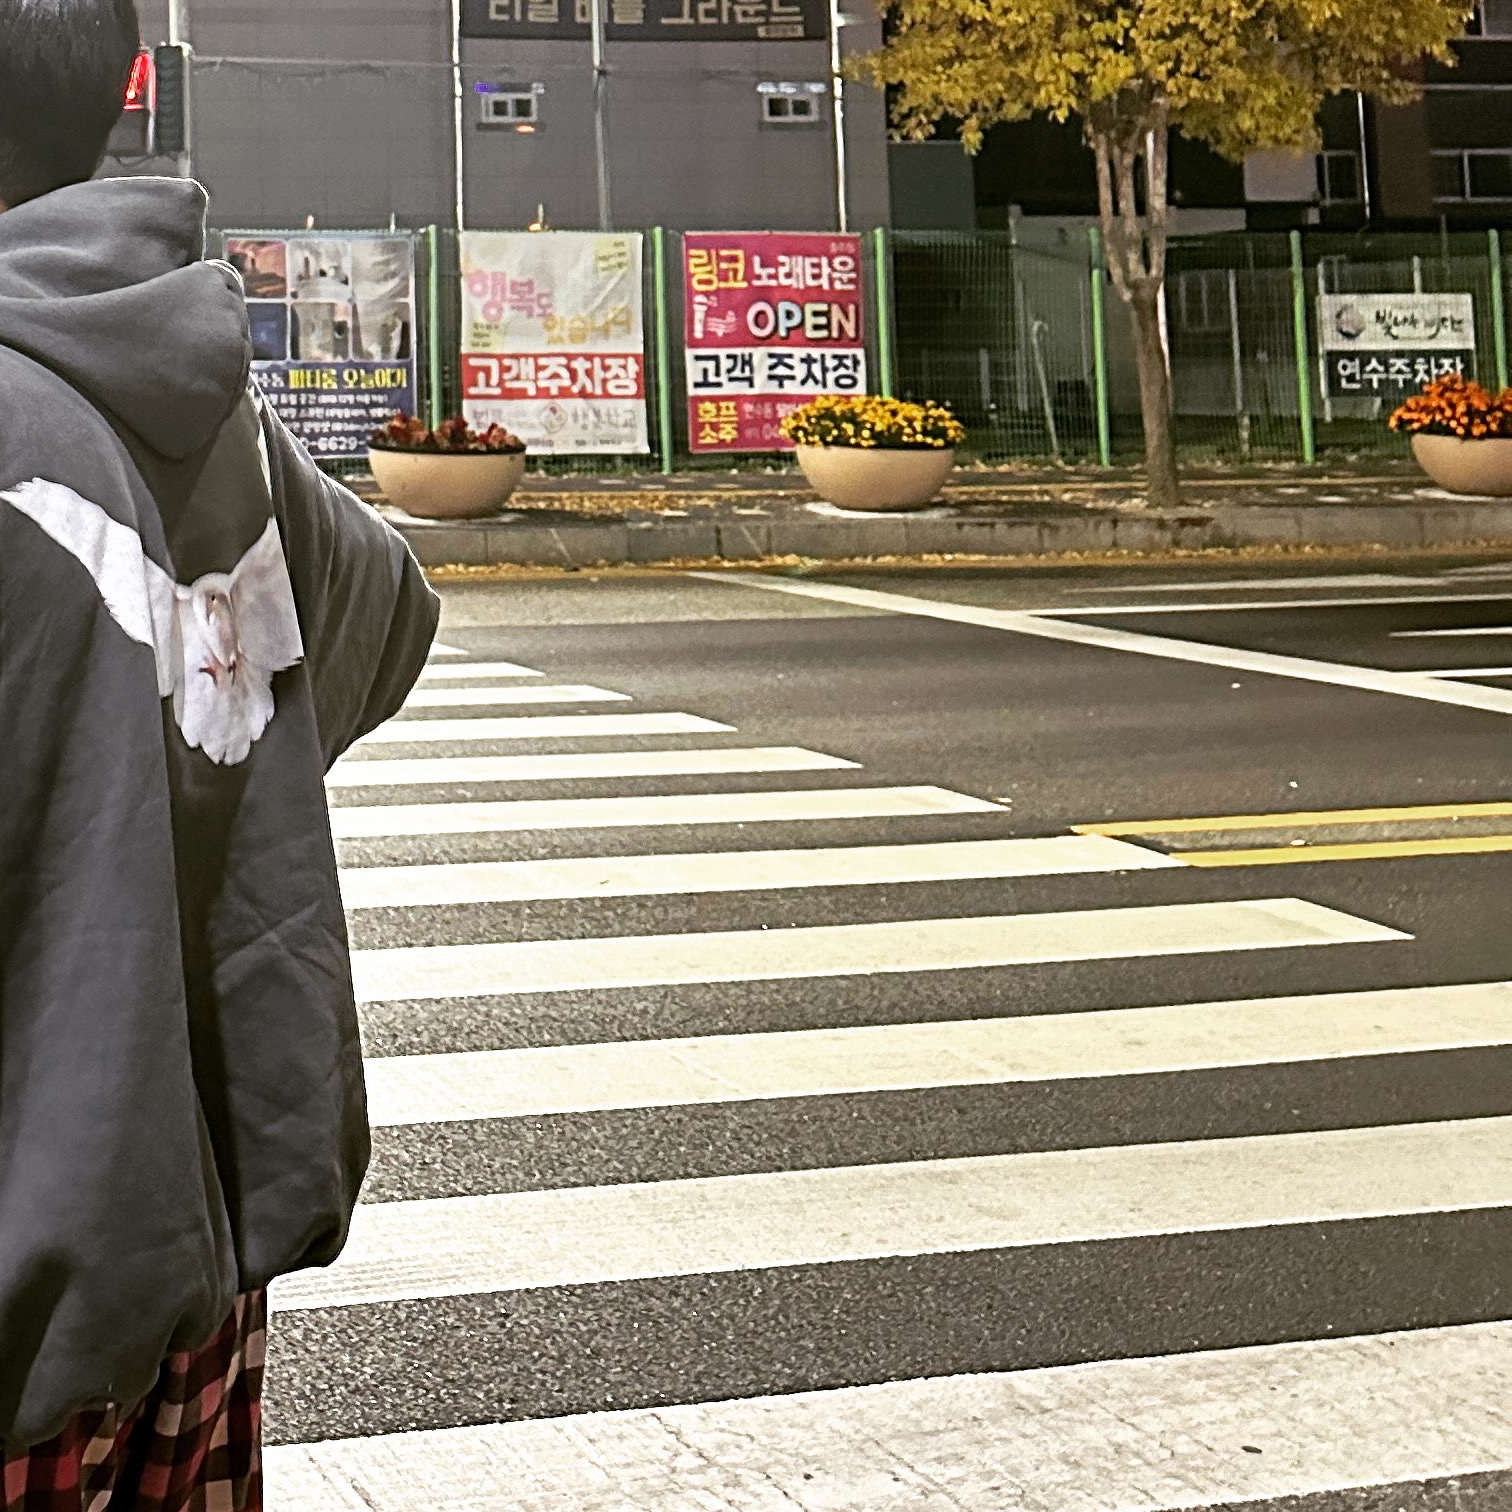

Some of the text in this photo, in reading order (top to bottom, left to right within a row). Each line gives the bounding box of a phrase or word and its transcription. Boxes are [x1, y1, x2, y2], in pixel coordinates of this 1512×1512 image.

[689, 249, 856, 291] 링코 노래타운
[746, 300, 857, 338] OPEN
[468, 357, 640, 396] 고객주차장
[693, 353, 860, 389] 고객 주차장
[697, 401, 738, 422] 호프
[697, 424, 738, 444] 소주
